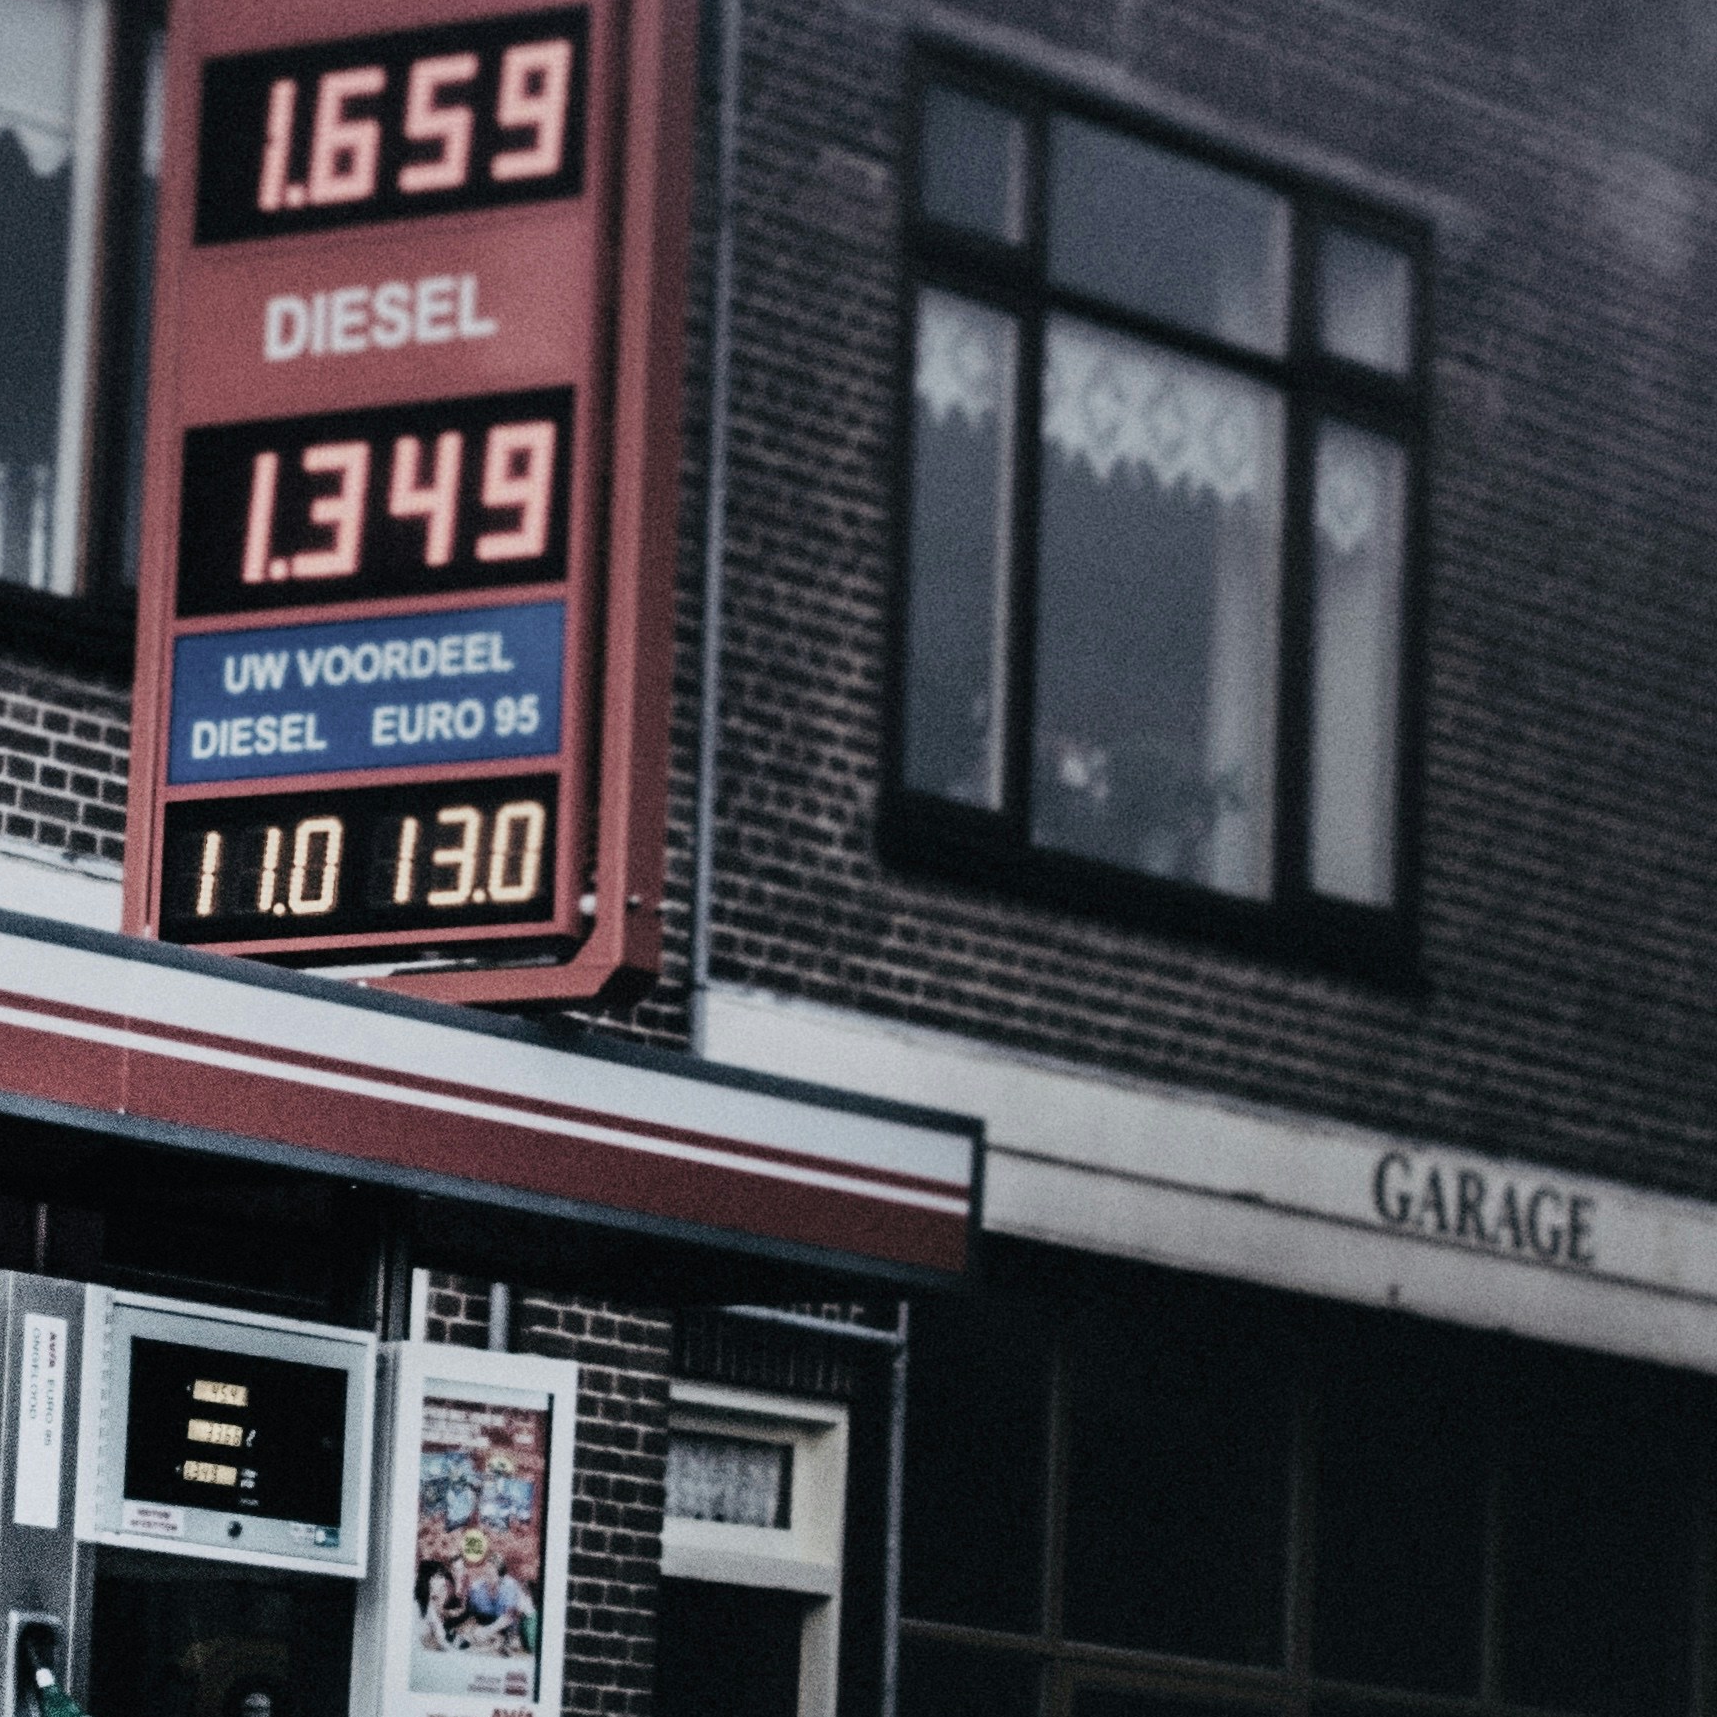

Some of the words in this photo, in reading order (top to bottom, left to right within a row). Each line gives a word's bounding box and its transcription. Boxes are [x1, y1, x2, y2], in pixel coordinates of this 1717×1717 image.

[258, 40, 572, 211] 1.659
[263, 276, 498, 364] DIESEL
[242, 420, 555, 585] 1.349
[223, 650, 287, 695] UW
[296, 630, 513, 687] VOORDEEL
[191, 712, 326, 760] DIESEL
[372, 698, 485, 747] EURO
[492, 692, 540, 737] 95
[393, 800, 546, 906] 13.0
[1373, 1150, 1595, 1268] GARAGE
